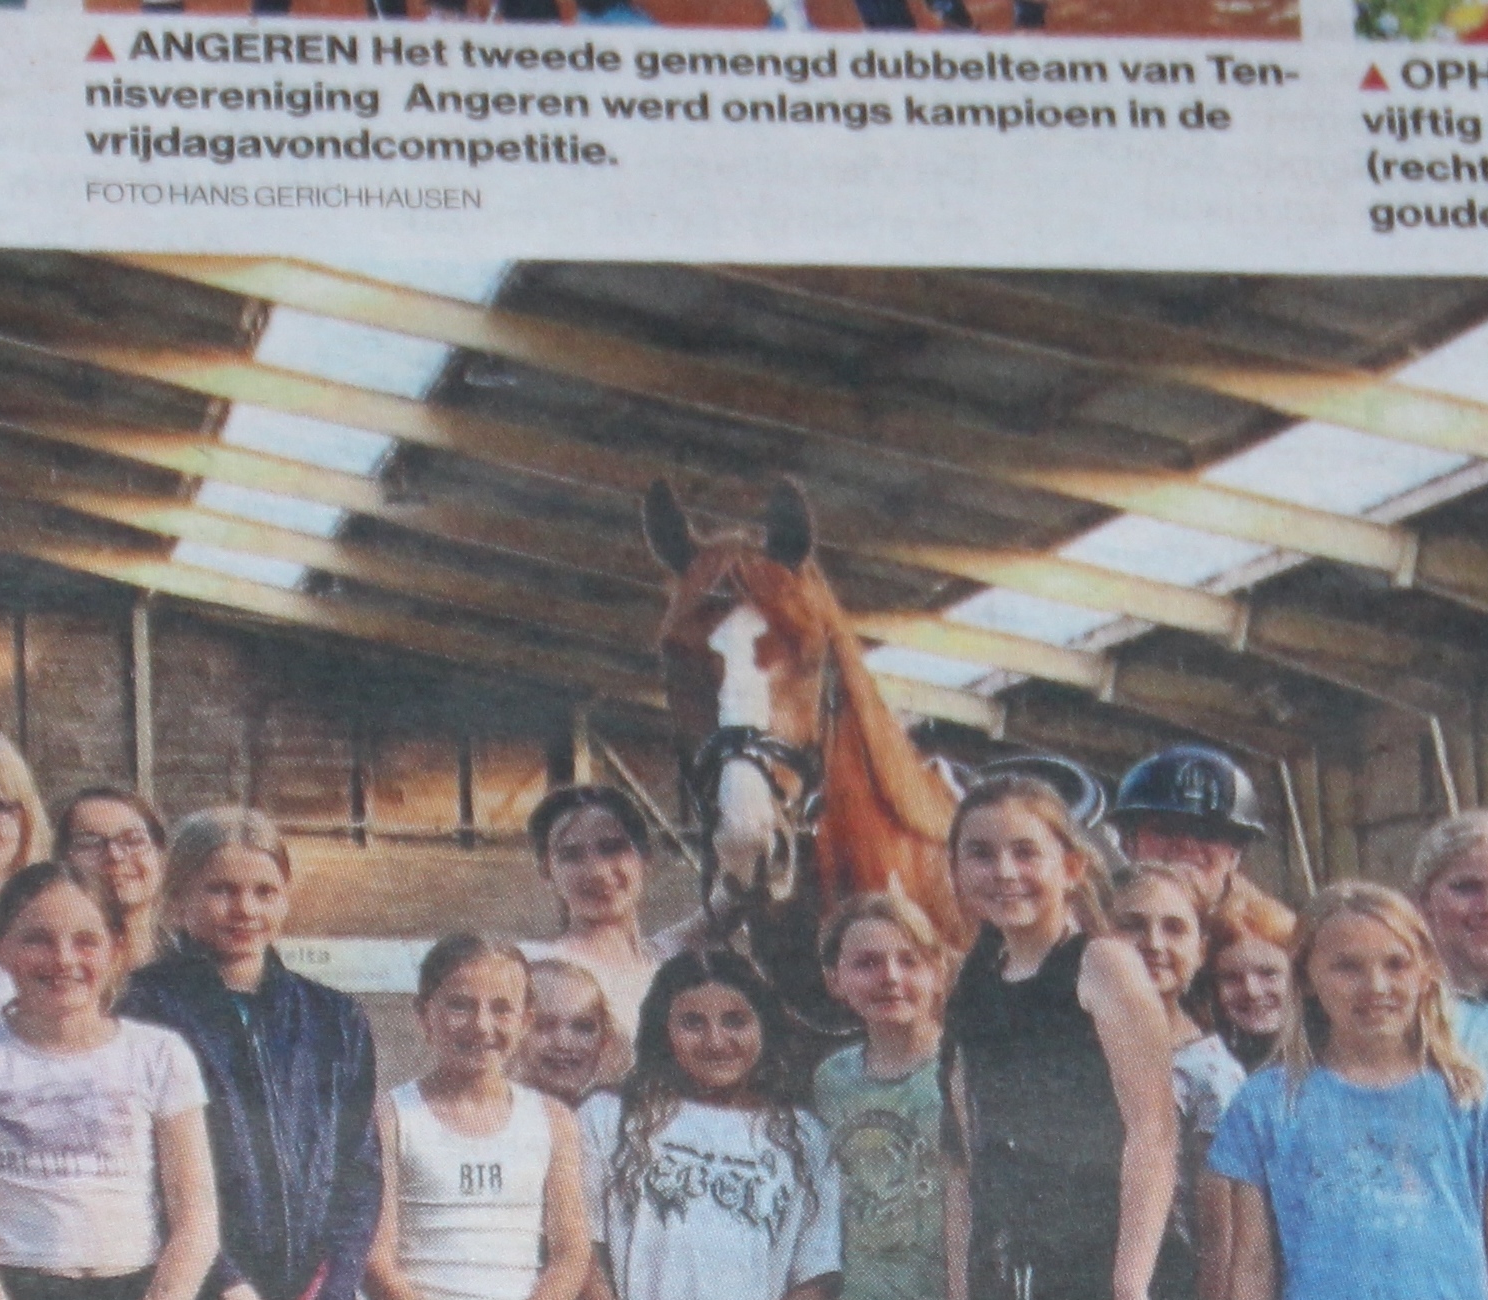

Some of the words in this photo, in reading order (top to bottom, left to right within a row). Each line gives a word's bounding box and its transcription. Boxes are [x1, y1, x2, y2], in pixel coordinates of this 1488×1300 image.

[130, 31, 358, 64] ANGEREN
[373, 36, 447, 66] Het
[461, 40, 621, 71] tweede
[635, 49, 837, 83] gemengd
[850, 50, 1107, 81] dubbelteam
[1121, 62, 1195, 83] van
[1208, 55, 1298, 85] Ten-
[86, 78, 379, 118] nisvereniging
[406, 83, 589, 120] Angeren
[603, 92, 709, 121] werd
[723, 94, 892, 130] onlangs
[905, 96, 1116, 132] kampioen
[1129, 99, 1166, 127] in
[1179, 100, 1231, 130] de
[1363, 107, 1481, 144] vijftig
[86, 126, 617, 167] vrijdagavondcompetitie.
[86, 181, 164, 206] FOTO
[169, 182, 249, 207] HANS
